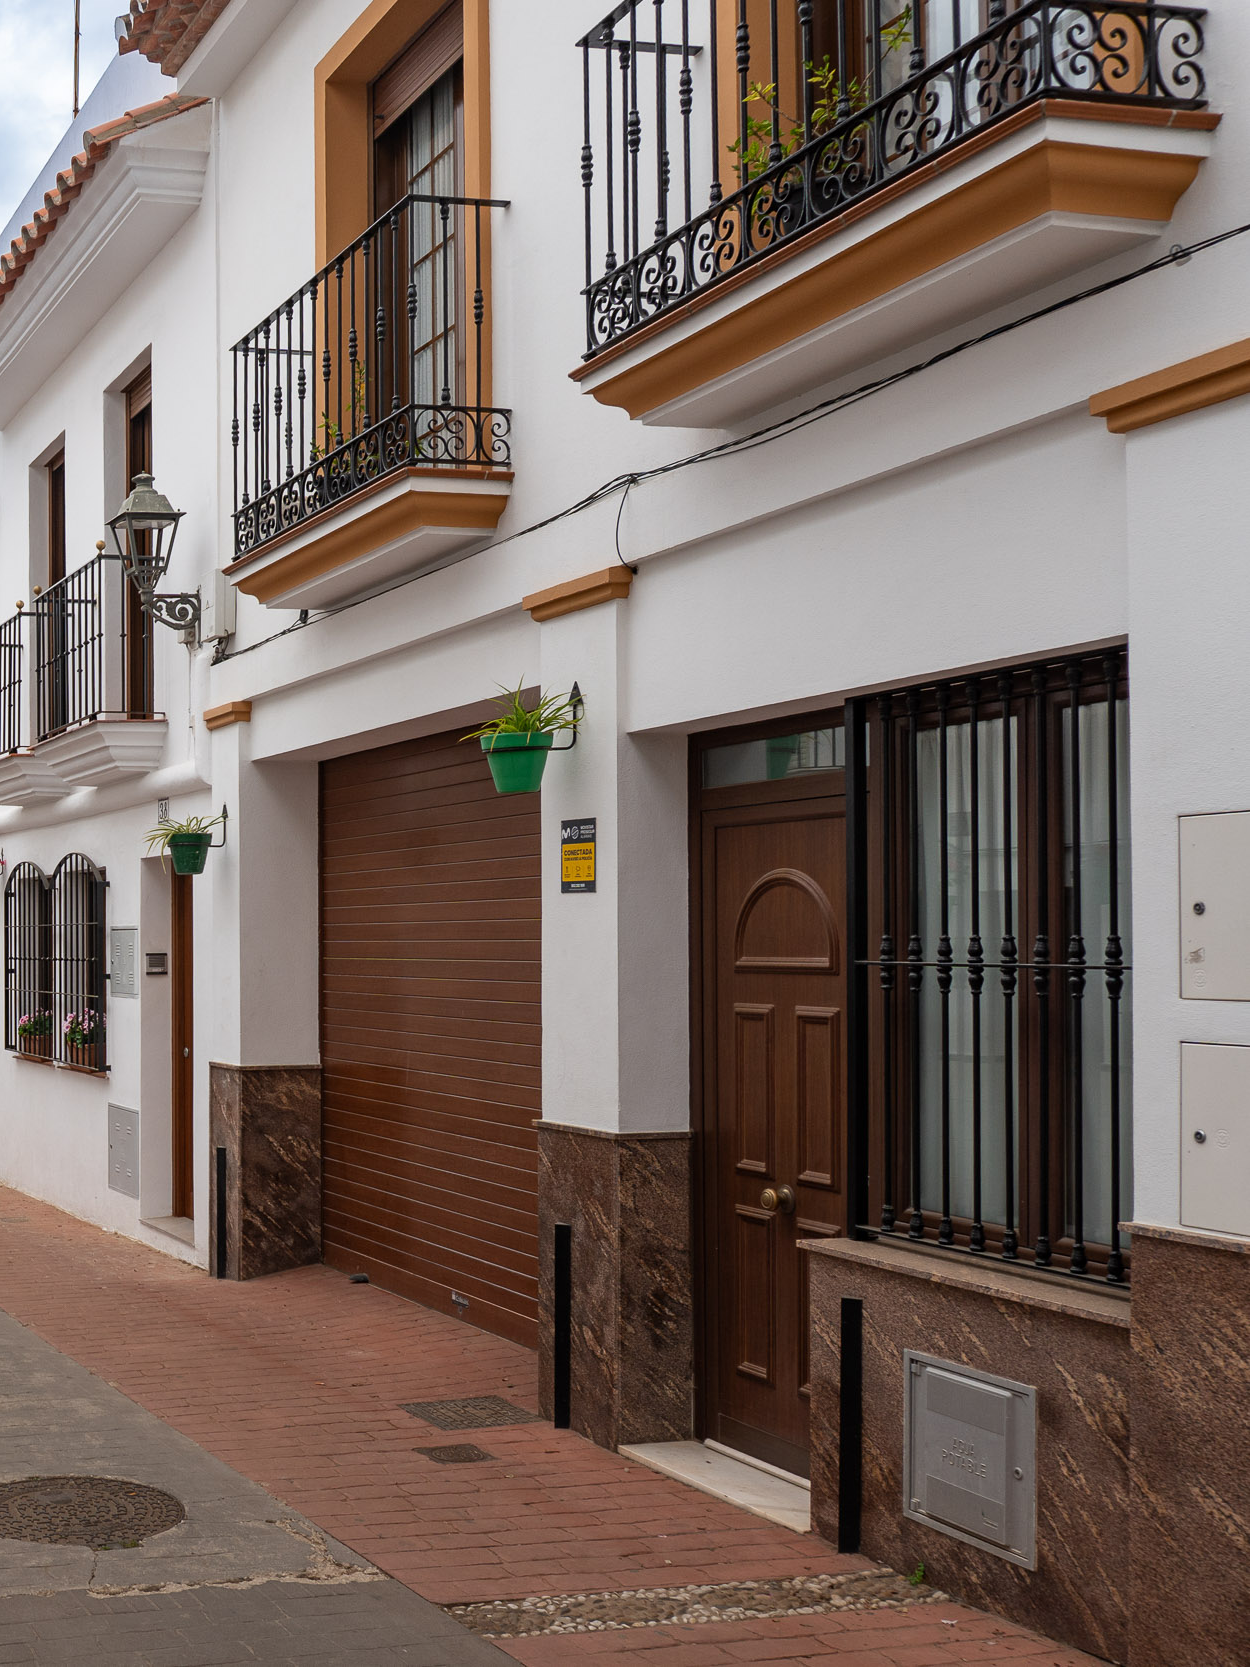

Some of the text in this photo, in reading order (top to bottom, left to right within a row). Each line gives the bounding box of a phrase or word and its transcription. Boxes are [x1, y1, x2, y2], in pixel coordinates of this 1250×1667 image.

[159, 801, 168, 819] 38
[564, 848, 592, 856] CONECTADA
[951, 1436, 975, 1455] AGUA
[942, 1448, 987, 1478] POTABLE
